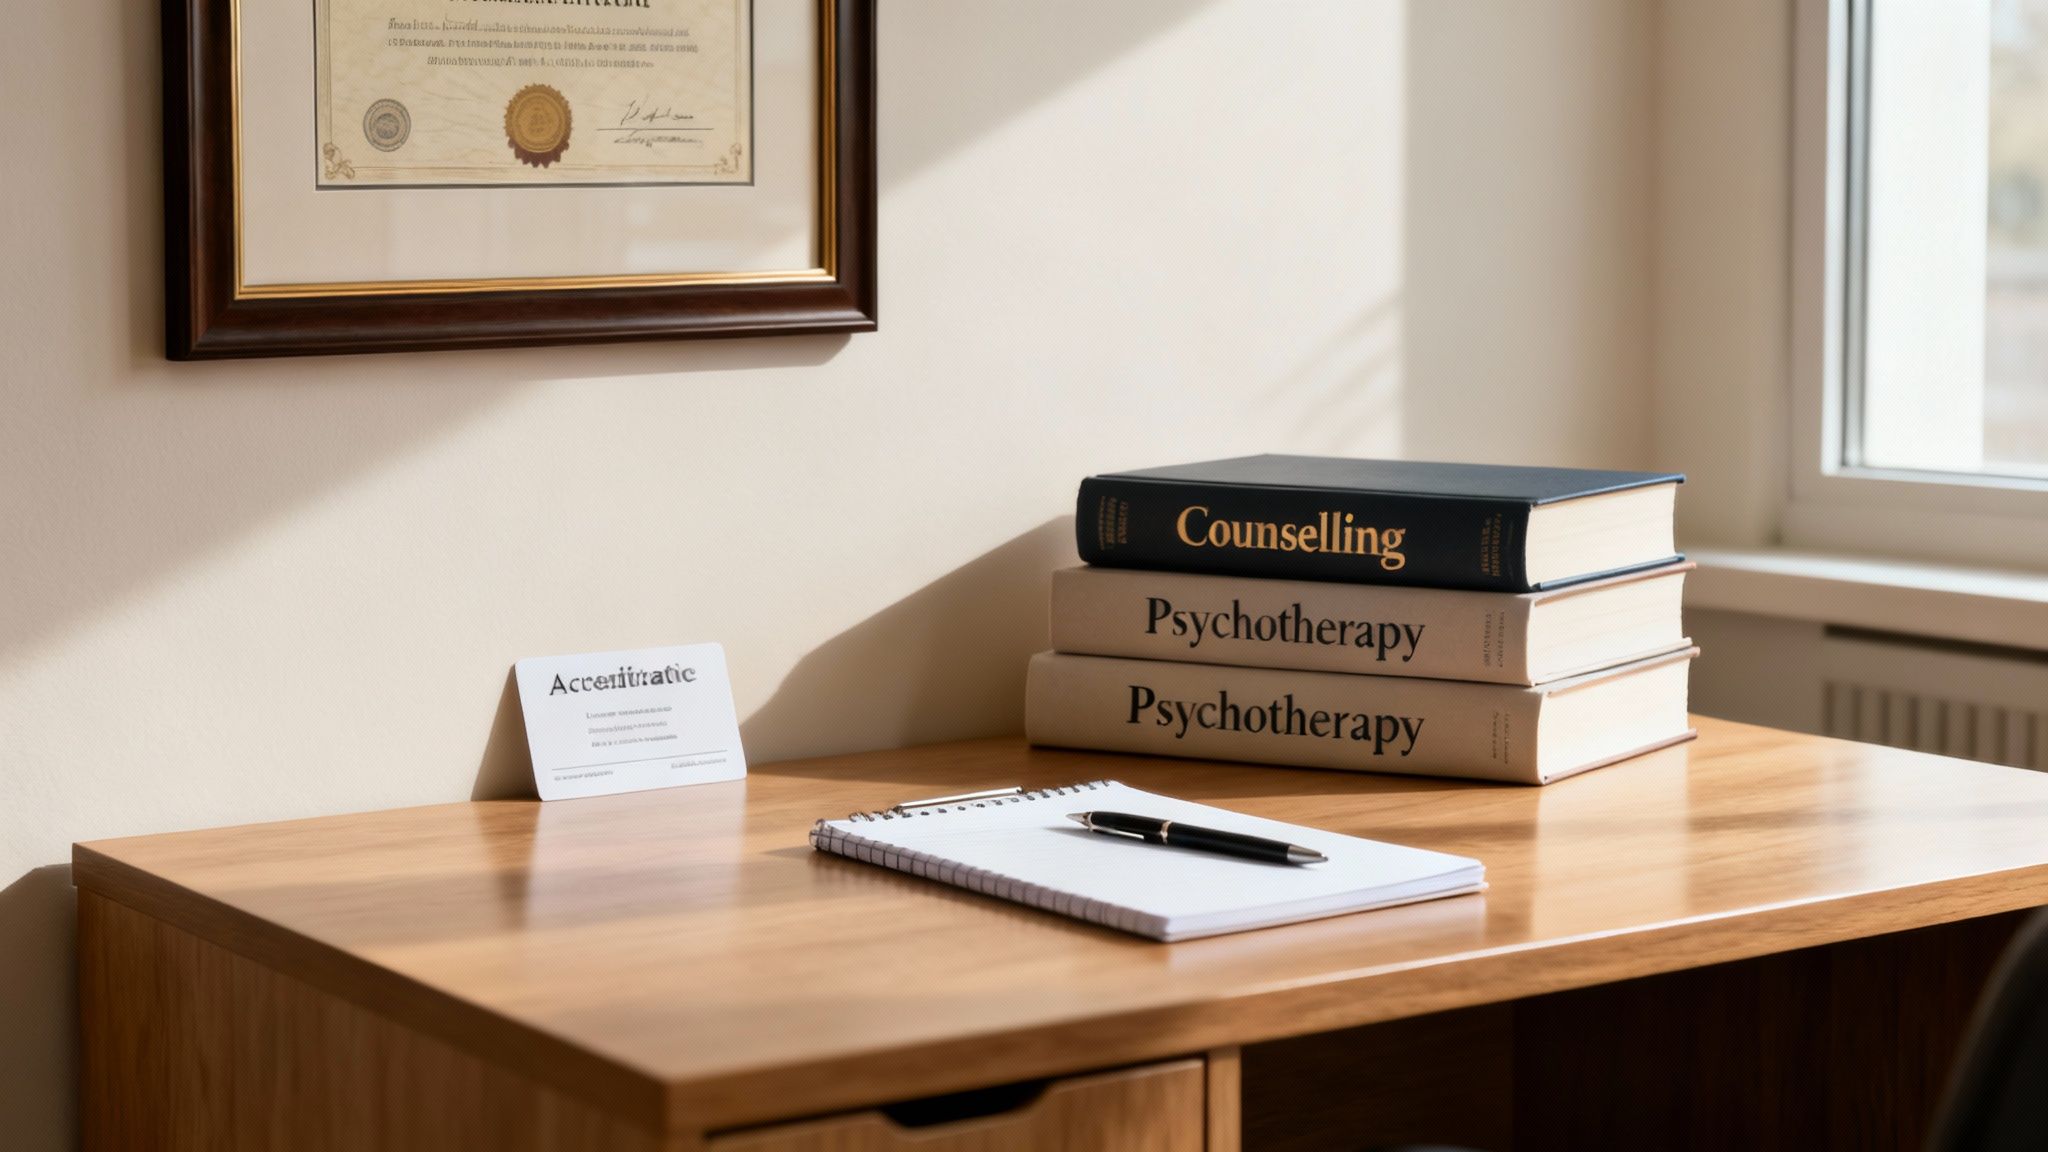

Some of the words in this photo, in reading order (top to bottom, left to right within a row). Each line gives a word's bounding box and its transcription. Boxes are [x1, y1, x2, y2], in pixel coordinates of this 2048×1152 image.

[1177, 506, 1405, 570] Counselling
[1145, 597, 1425, 662] Psychotherapy
[1126, 686, 1425, 756] Psychotherapy
